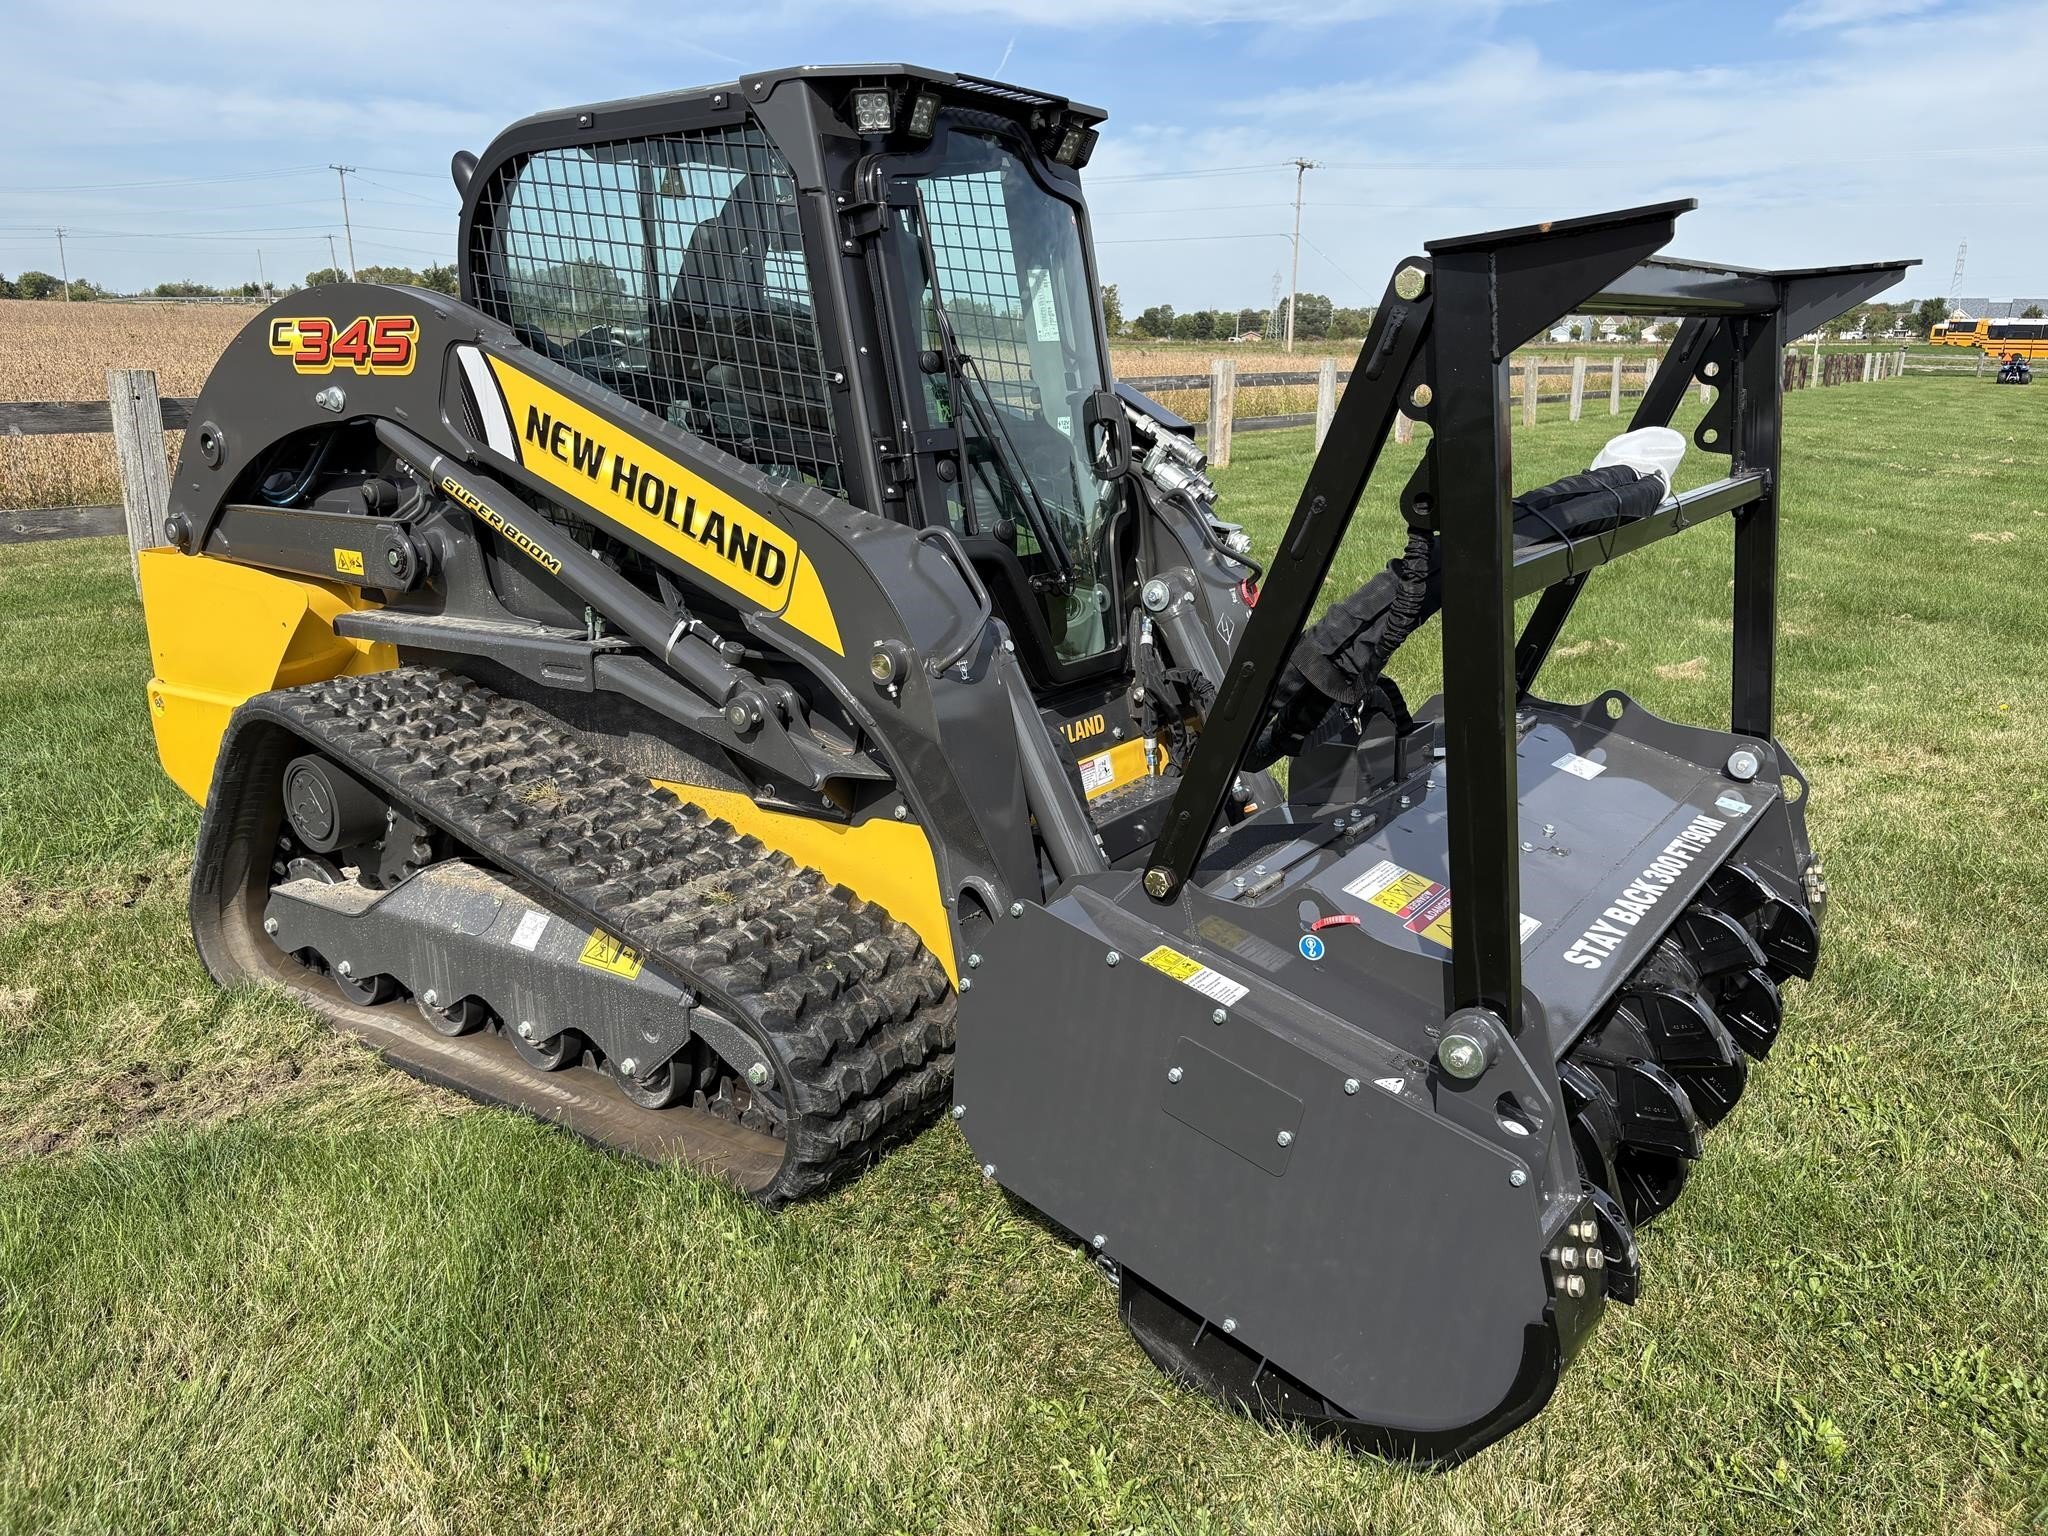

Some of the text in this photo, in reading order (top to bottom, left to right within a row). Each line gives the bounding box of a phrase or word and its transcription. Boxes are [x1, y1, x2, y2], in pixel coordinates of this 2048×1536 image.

[270, 316, 418, 372] C345
[442, 477, 560, 573] SUPER BOOM
[525, 404, 787, 587] NEW HOLLAND
[1563, 918, 1629, 969] STAY
[1603, 877, 1669, 926] BACK
